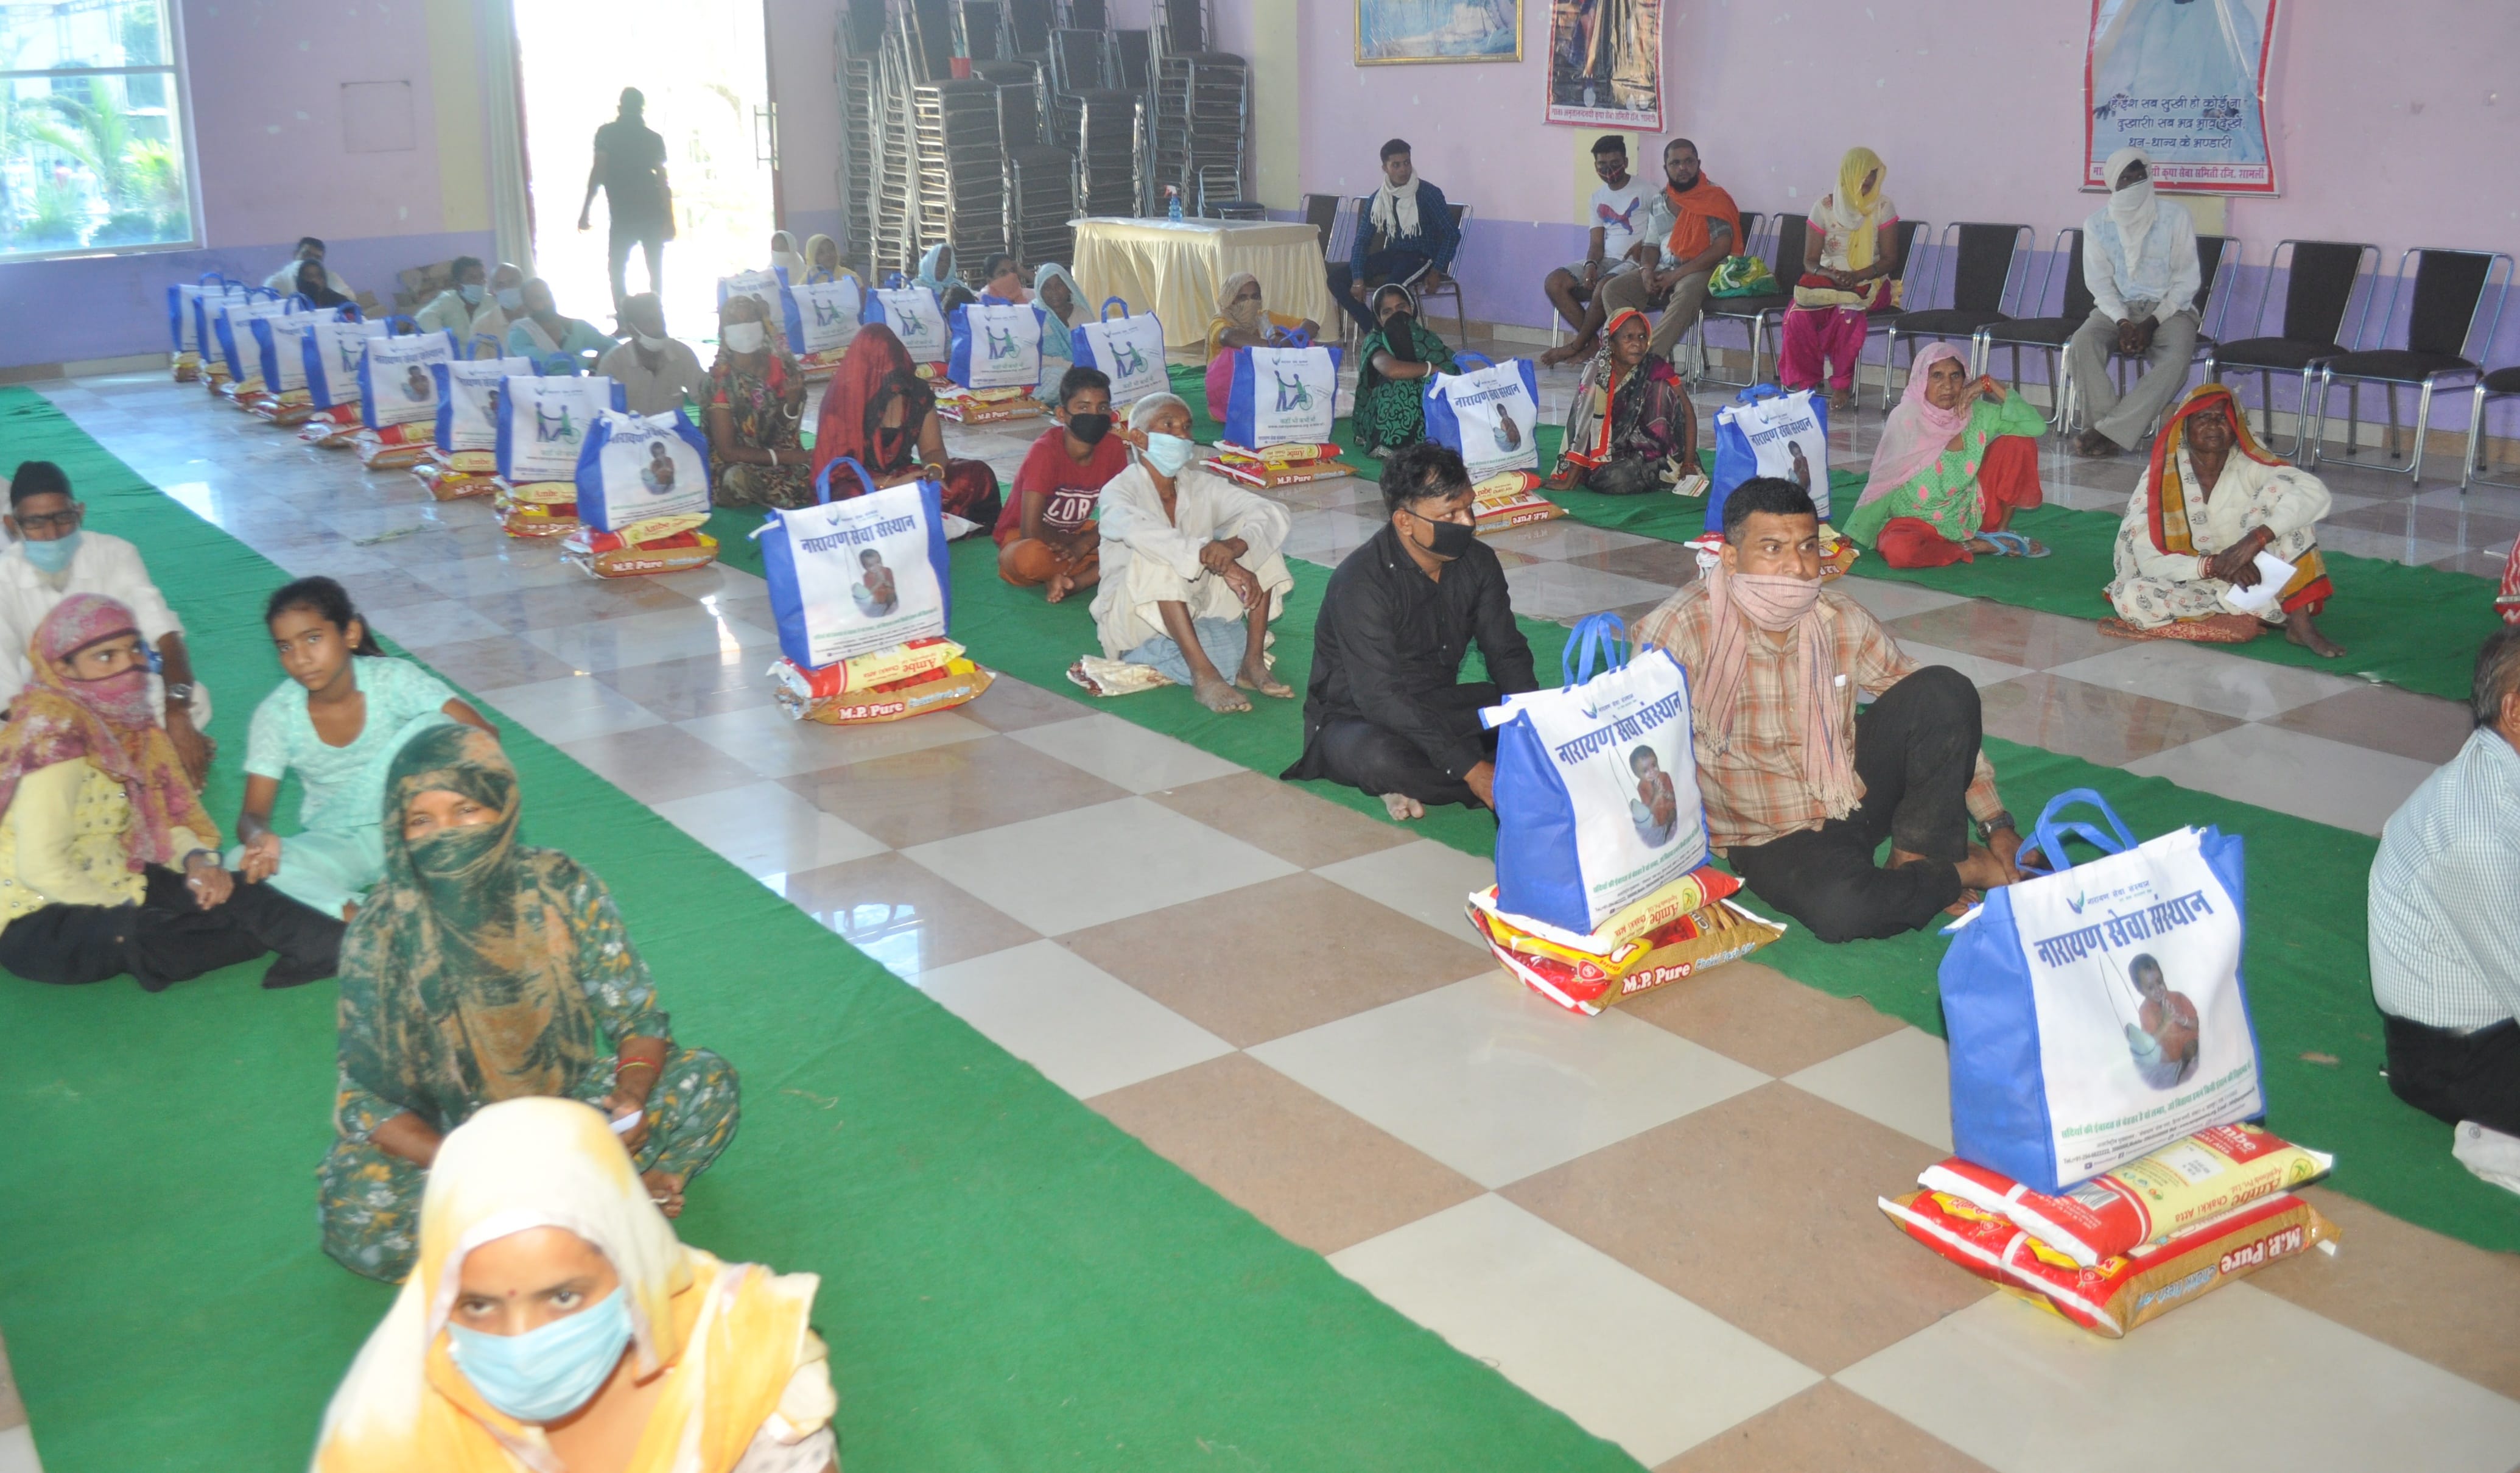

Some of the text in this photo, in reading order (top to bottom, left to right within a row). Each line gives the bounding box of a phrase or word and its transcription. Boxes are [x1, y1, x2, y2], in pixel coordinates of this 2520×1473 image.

[2141, 98, 2157, 108] सब
[2161, 96, 2187, 113] सुखी
[2203, 95, 2227, 111] कोई
[2158, 118, 2174, 128] सब
[2179, 134, 2190, 147] के
[870, 701, 904, 719] Pure
[1555, 725, 1616, 765] नारायण
[1612, 714, 1643, 742] सेवा
[1635, 691, 1682, 729] संस्थान
[1649, 901, 1679, 925] Ambe
[2034, 890, 2214, 968] नारायण सेवा संस्थान
[1622, 971, 1651, 995] M.P.
[1654, 963, 1691, 986] Pure
[2175, 1207, 2194, 1223] Atta
[2198, 1194, 2228, 1215] Chakki
[2268, 1226, 2302, 1257] M.P.
[2221, 1240, 2264, 1273] Pure
